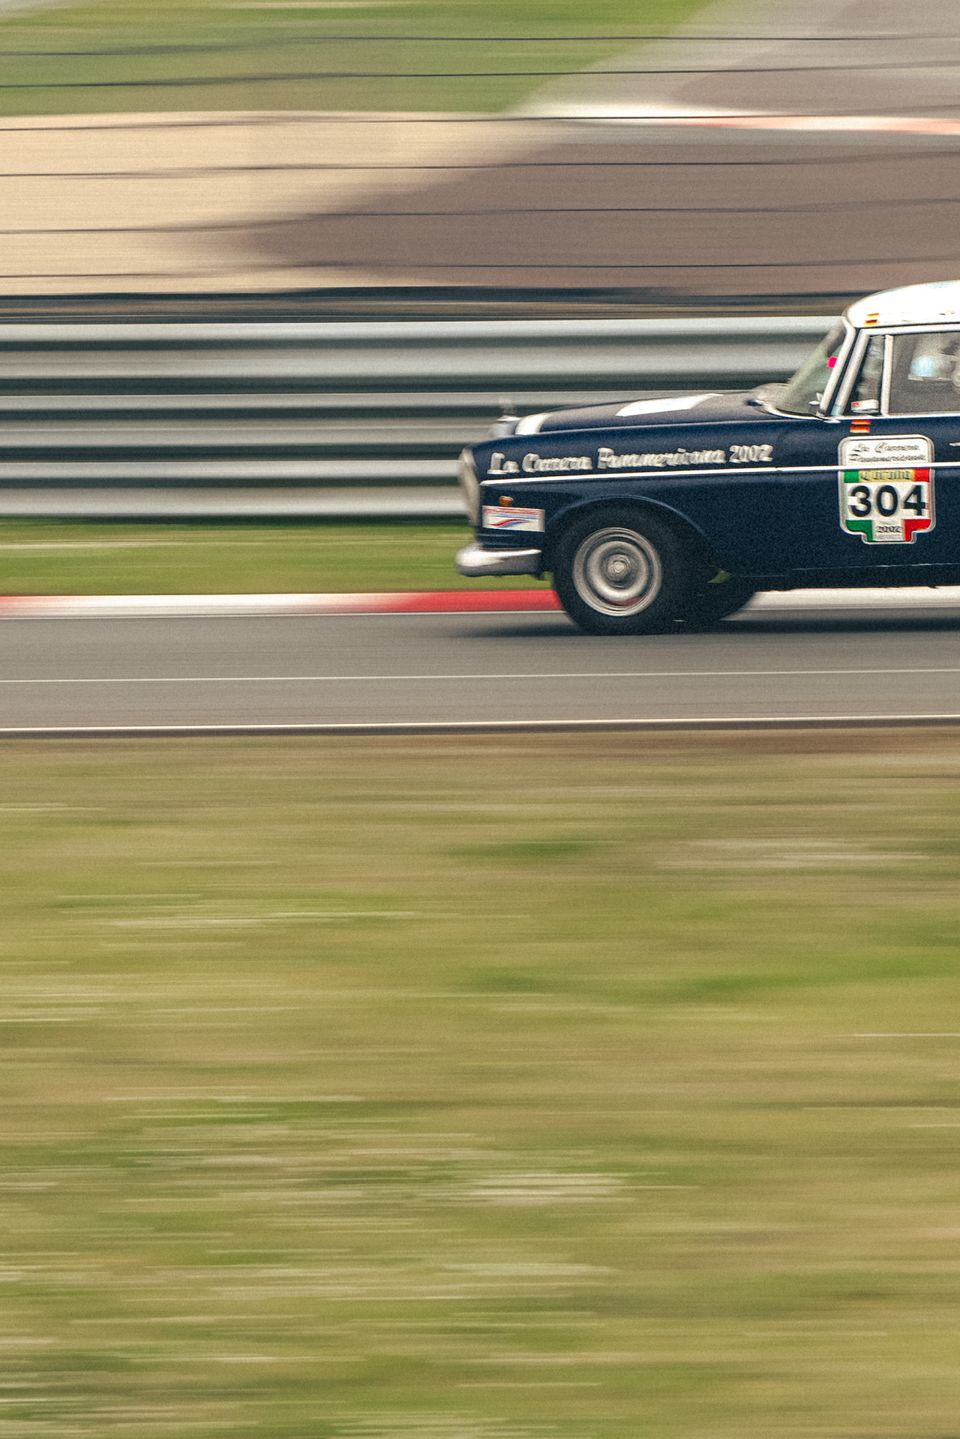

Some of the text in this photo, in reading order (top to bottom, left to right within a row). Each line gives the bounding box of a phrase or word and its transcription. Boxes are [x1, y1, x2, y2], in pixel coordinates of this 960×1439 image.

[487, 452, 519, 474] La
[729, 444, 774, 463] 2002
[849, 484, 927, 517] 304
